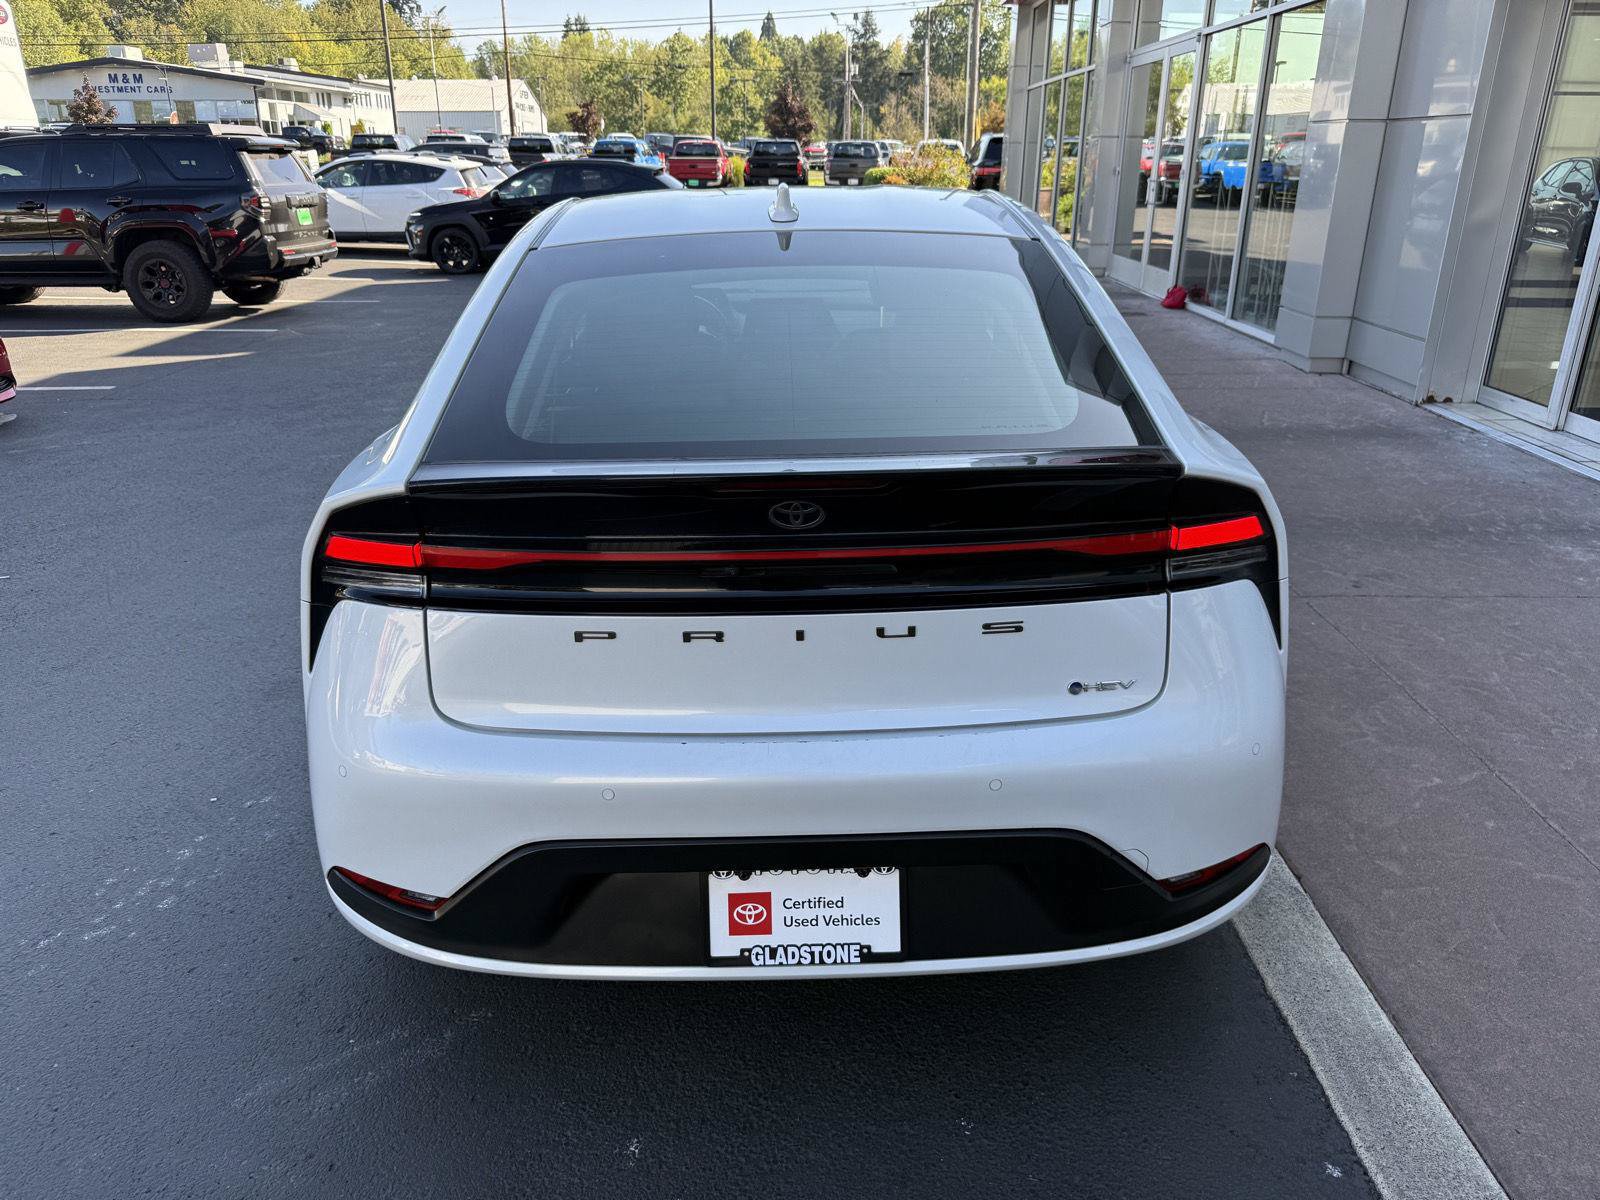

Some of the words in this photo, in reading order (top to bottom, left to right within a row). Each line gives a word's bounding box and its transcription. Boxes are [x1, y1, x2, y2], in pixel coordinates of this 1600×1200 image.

[108, 73, 119, 84] M
[121, 74, 130, 84] &
[132, 73, 144, 84] M
[146, 86, 173, 95] CARS
[574, 620, 1023, 643] PRIUS
[1083, 679, 1137, 692] HEV
[783, 897, 844, 910] Certified
[783, 915, 819, 928] Used
[823, 914, 881, 927] Vehicles
[750, 943, 861, 966] GLADSTONE
